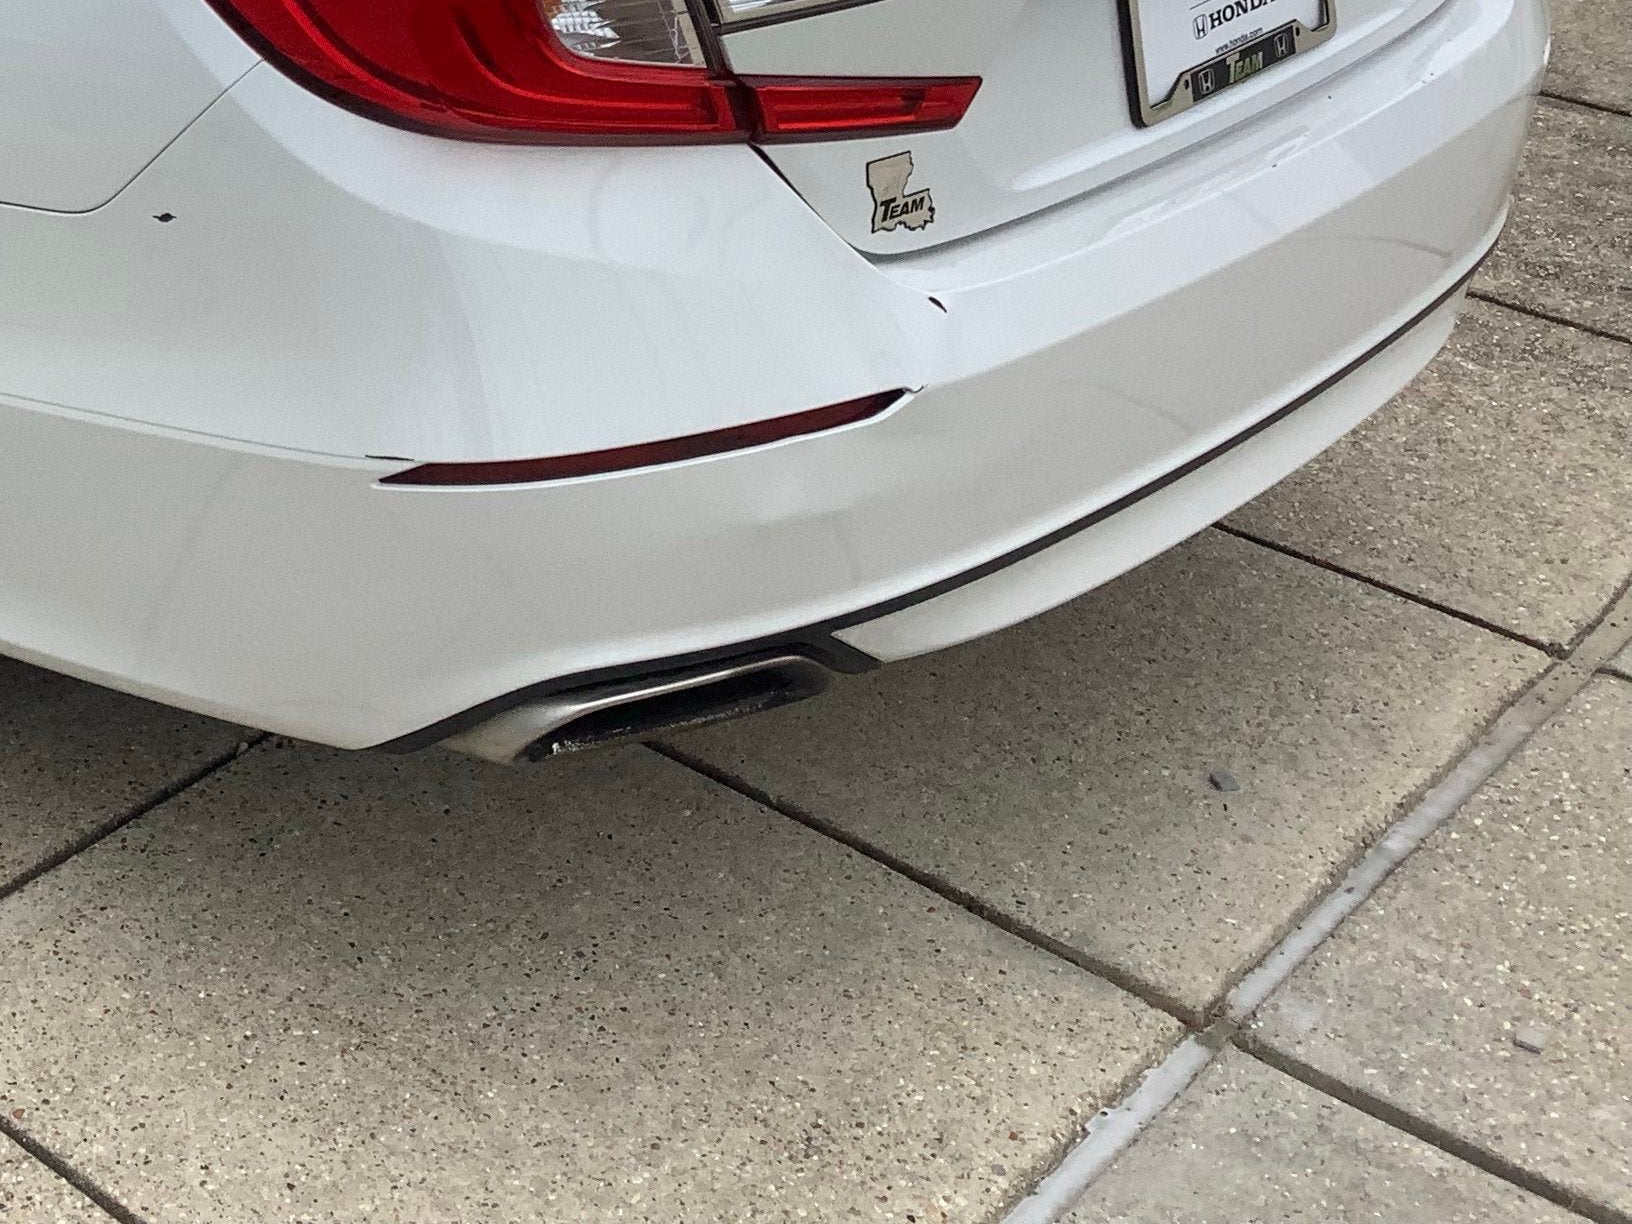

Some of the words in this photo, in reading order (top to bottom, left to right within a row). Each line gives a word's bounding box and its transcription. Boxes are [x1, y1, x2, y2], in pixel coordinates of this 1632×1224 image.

[1215, 28, 1265, 53] www.honda.com
[1226, 52, 1263, 83] TEAM
[879, 196, 925, 222] TEAM
